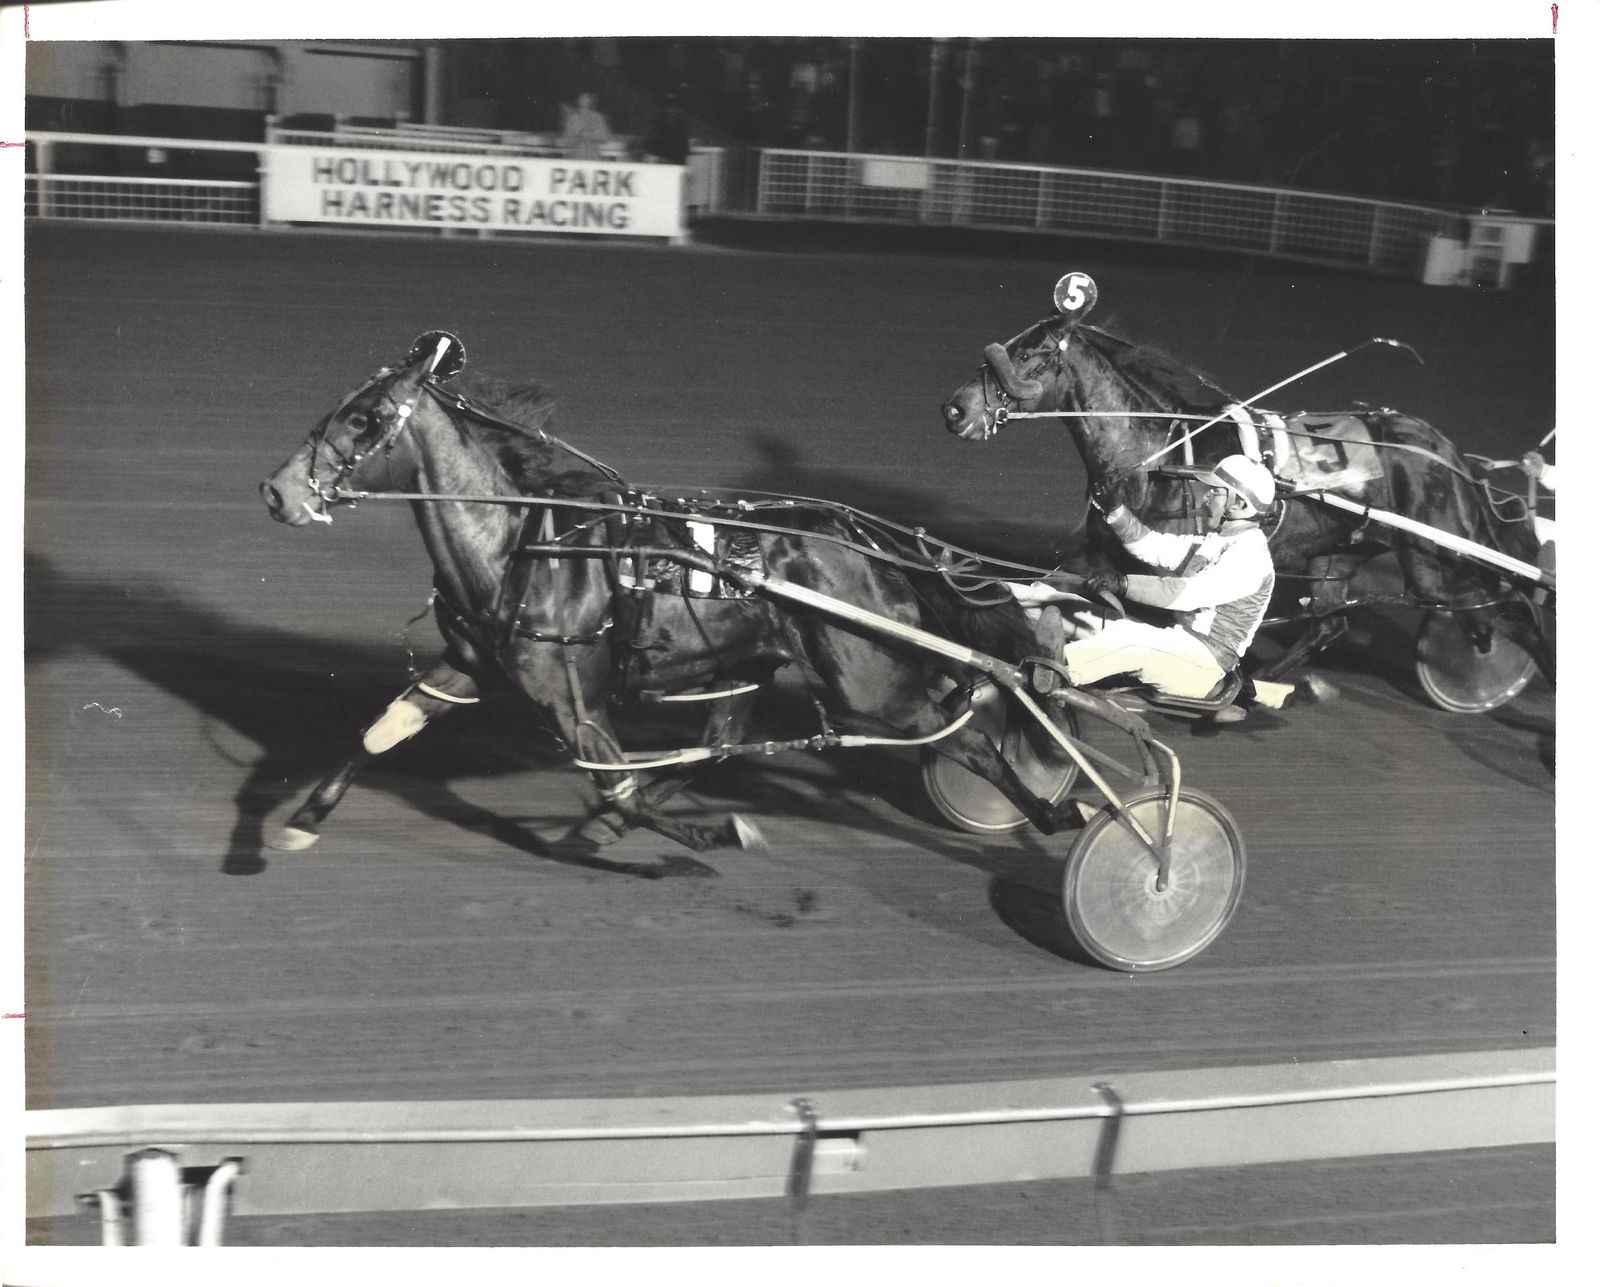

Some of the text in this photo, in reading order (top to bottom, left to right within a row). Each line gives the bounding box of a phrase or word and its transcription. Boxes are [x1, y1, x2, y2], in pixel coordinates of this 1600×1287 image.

[312, 157, 635, 197] HOLLYWOOD PARK
[320, 190, 630, 229] HARNESS RACING
[1063, 275, 1090, 311] 5
[1303, 423, 1349, 474] 5
